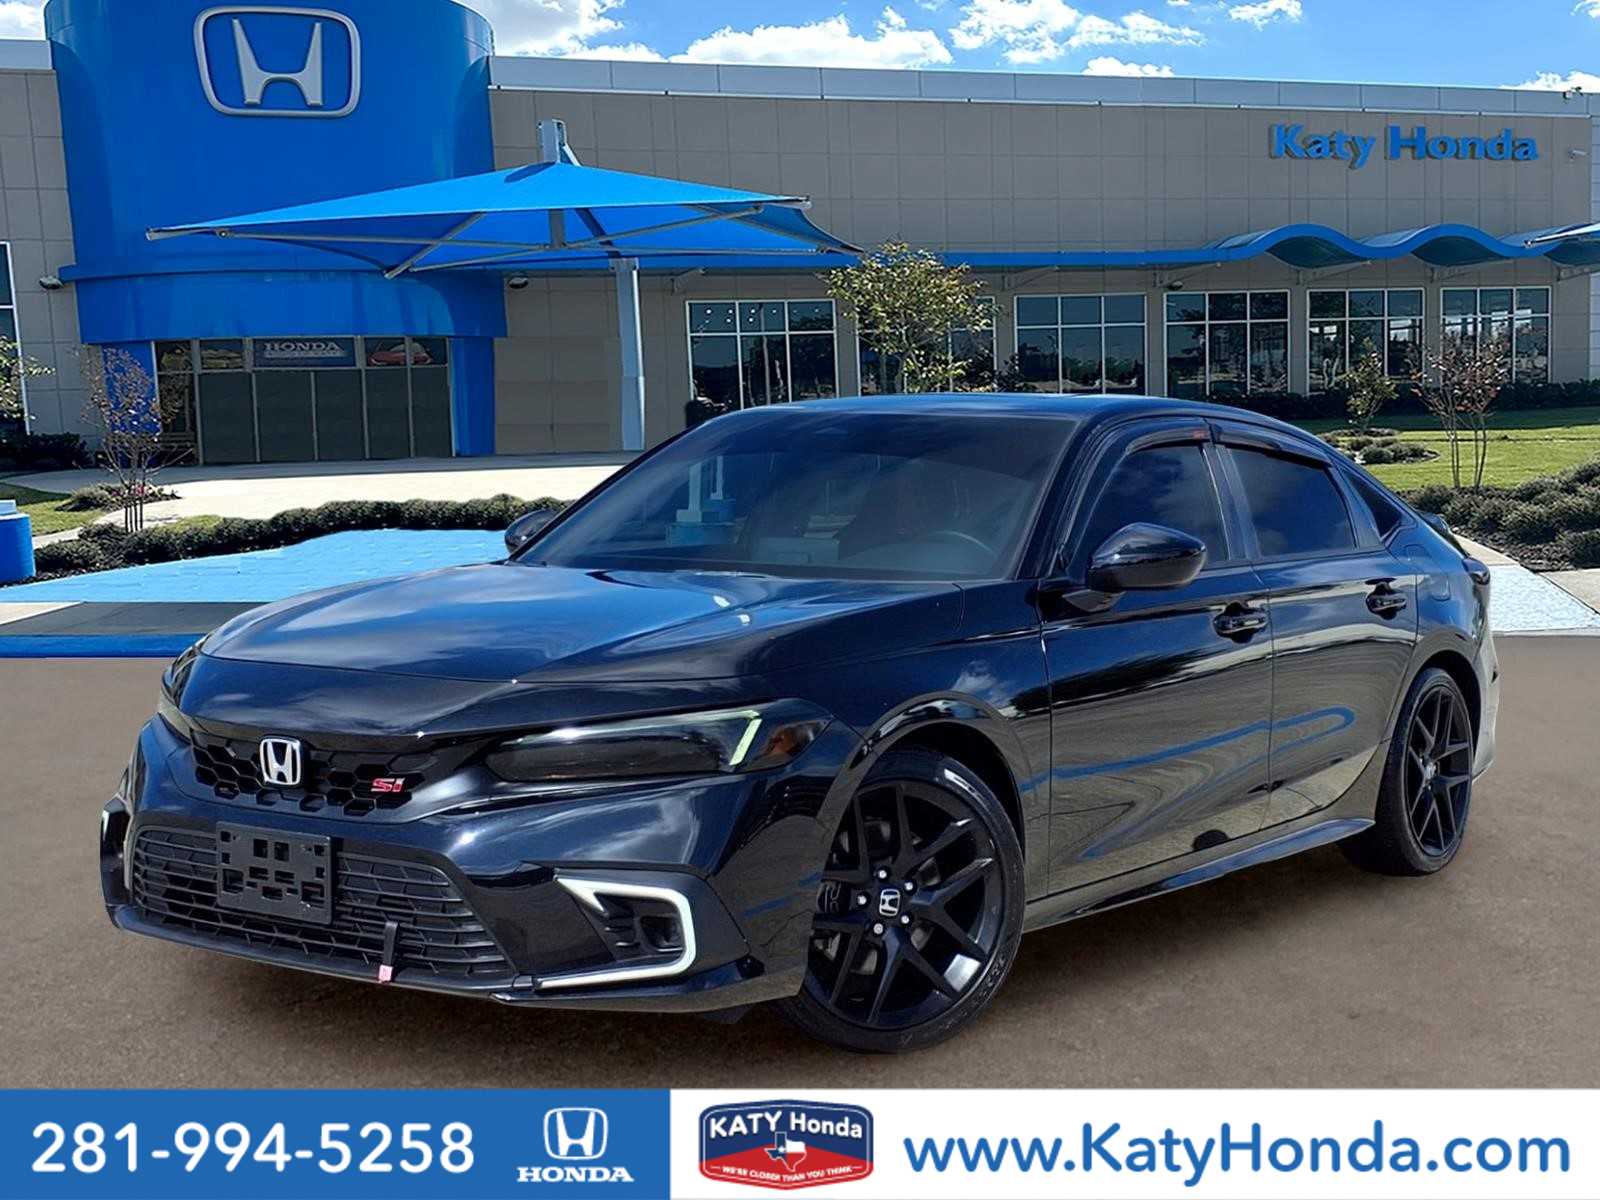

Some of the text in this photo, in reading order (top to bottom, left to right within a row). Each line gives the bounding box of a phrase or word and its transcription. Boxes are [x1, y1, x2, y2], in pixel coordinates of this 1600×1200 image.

[1271, 123, 1540, 169] Katy Honda
[264, 341, 344, 352] HONDA
